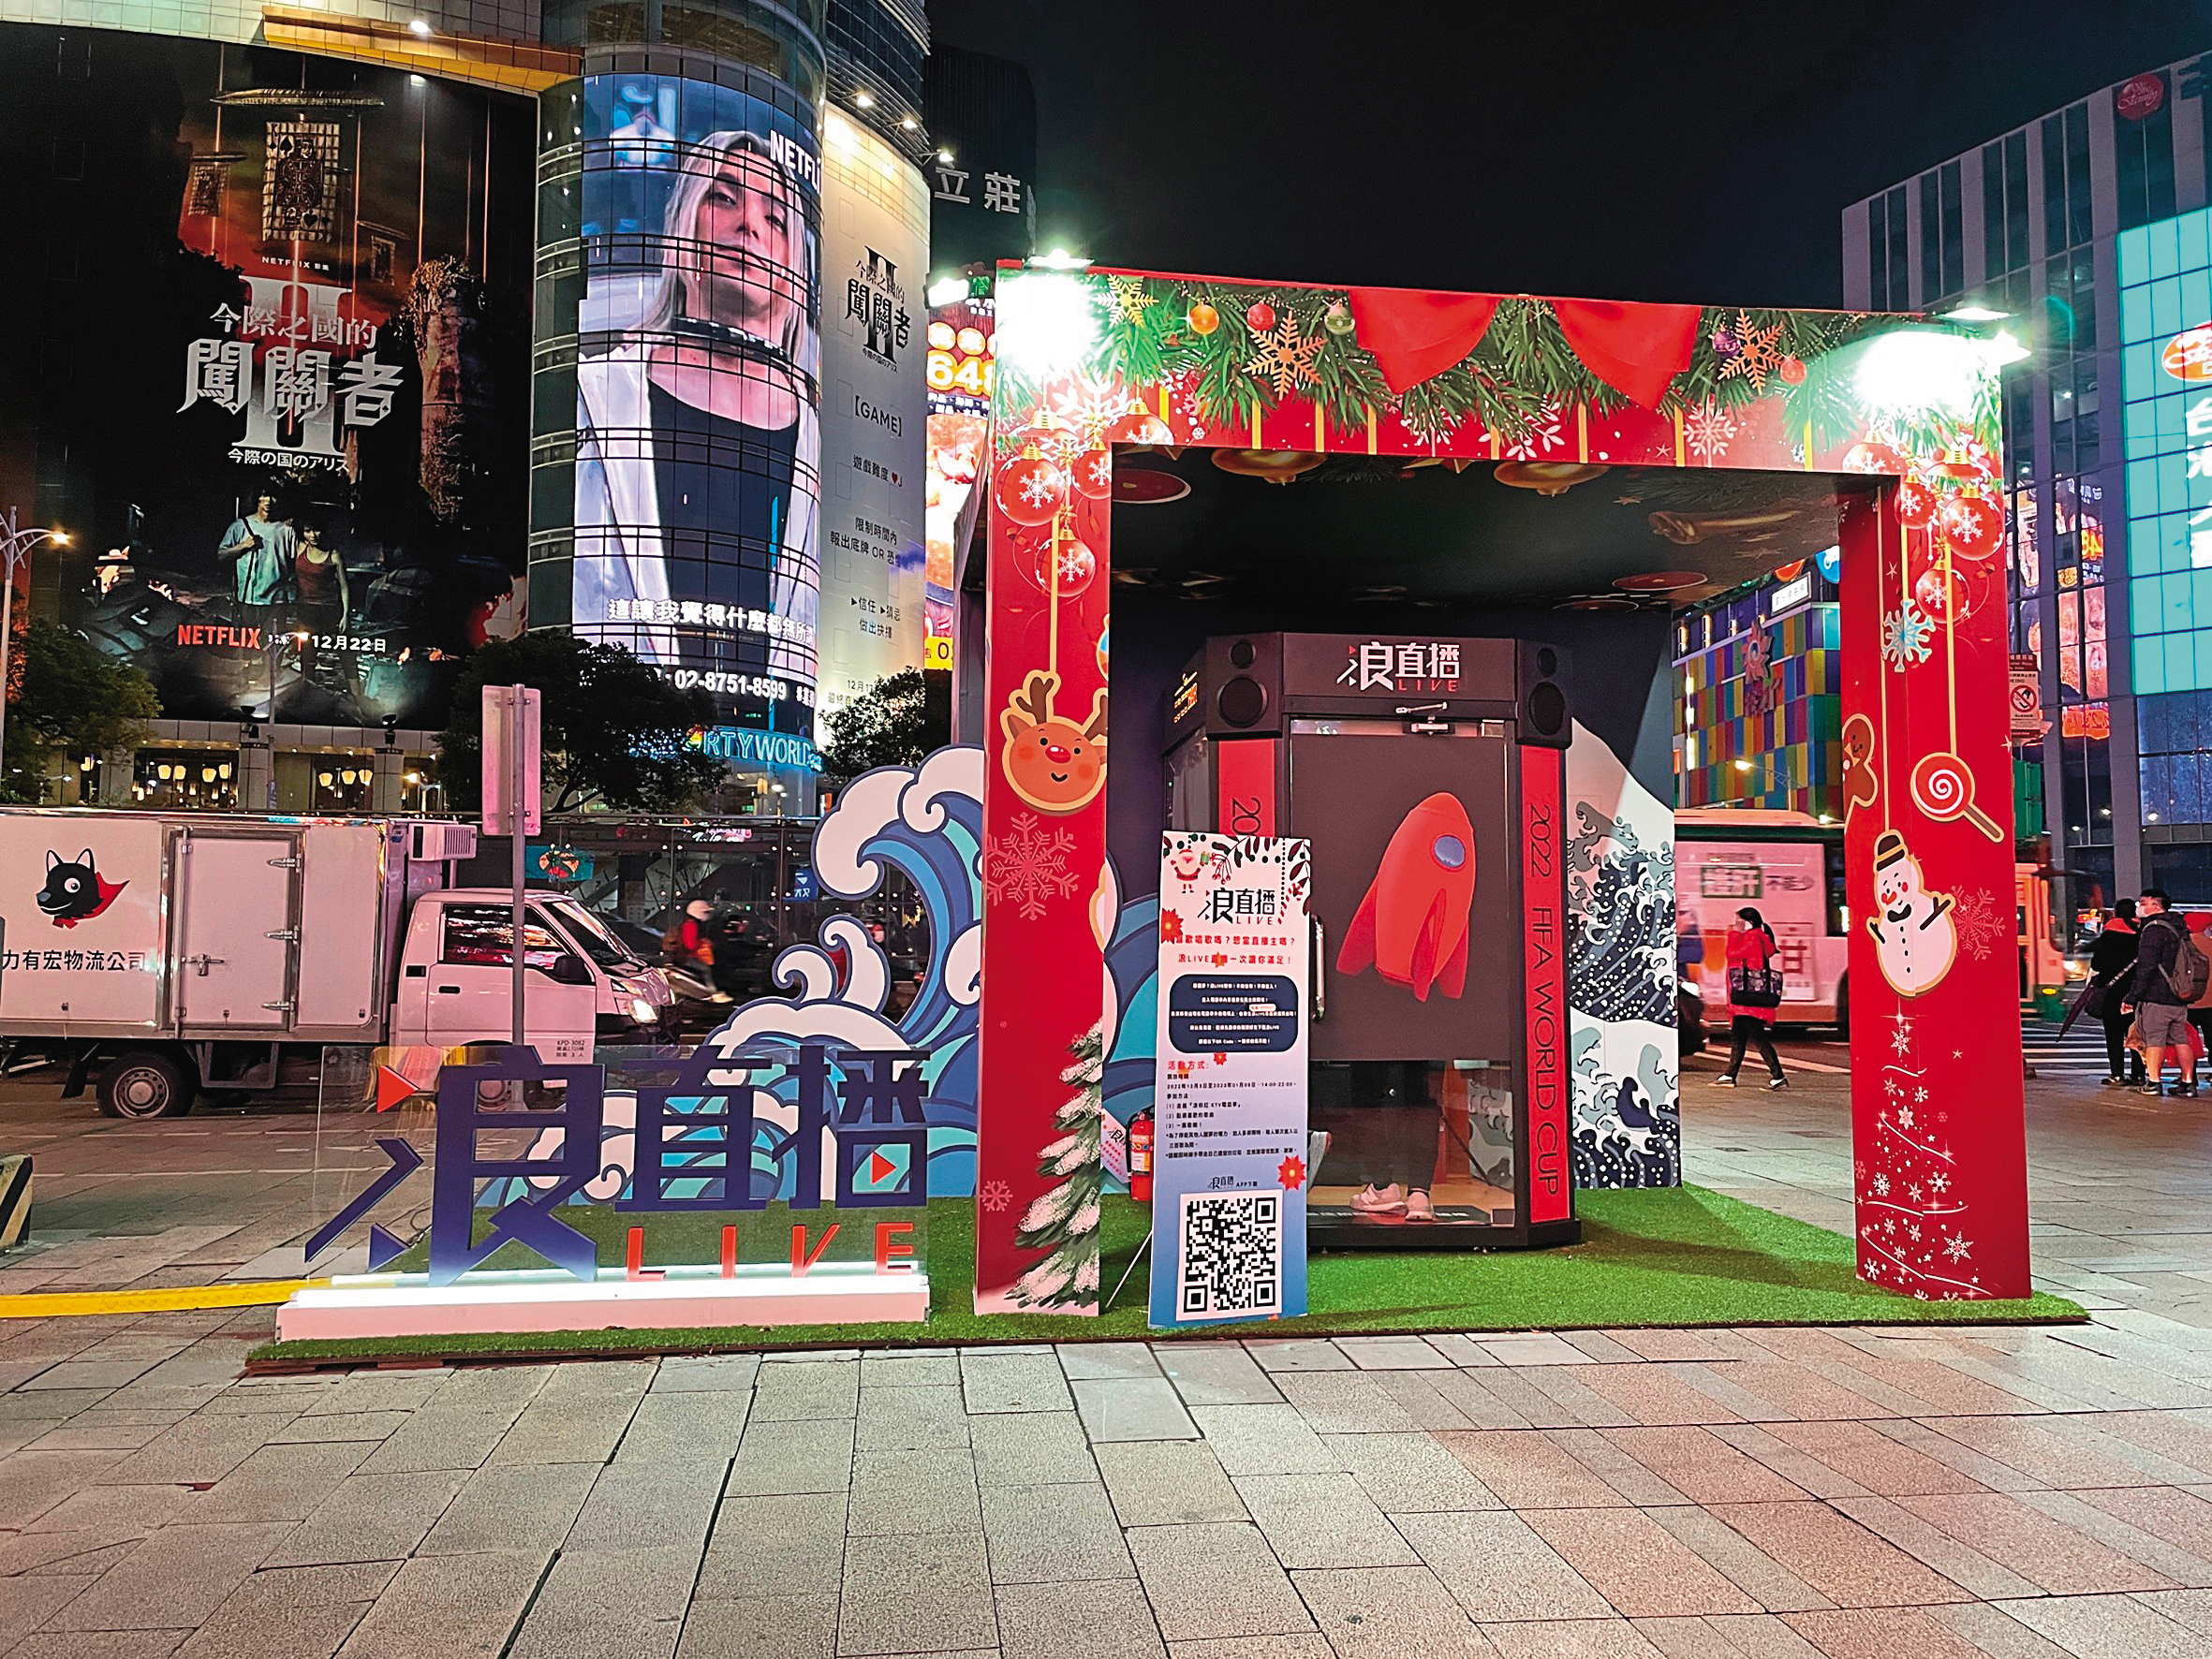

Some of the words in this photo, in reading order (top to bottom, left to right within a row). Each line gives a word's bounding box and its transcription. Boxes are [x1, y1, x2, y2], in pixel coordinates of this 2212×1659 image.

[771, 130, 820, 195] NETFLI
[935, 167, 1021, 214] 立莊
[210, 302, 377, 348] 今際之國的
[845, 278, 911, 349] 闖關者
[176, 338, 404, 427] 闖關者
[228, 448, 349, 473] 今際の国のアリス
[830, 531, 869, 555] 報出底牌
[872, 546, 885, 560] OR
[855, 517, 897, 545] 限制時間內
[858, 596, 876, 613] 信任
[178, 624, 260, 650] NETFLIX
[312, 635, 386, 653] 12月22日
[1336, 641, 1460, 691] 浪直播
[1398, 679, 1457, 691] LIVE
[1530, 803, 1552, 877] 2022
[1198, 888, 1275, 924] 浪直播
[1236, 916, 1274, 925] LIVE
[2, 949, 146, 972] 力有宏物流公司
[1532, 907, 1555, 970] FIFA
[1534, 979, 1556, 1111] WORLD
[304, 1044, 929, 1286] 浪直播
[1536, 1122, 1559, 1197] CUP
[626, 1222, 913, 1283] LIVE
